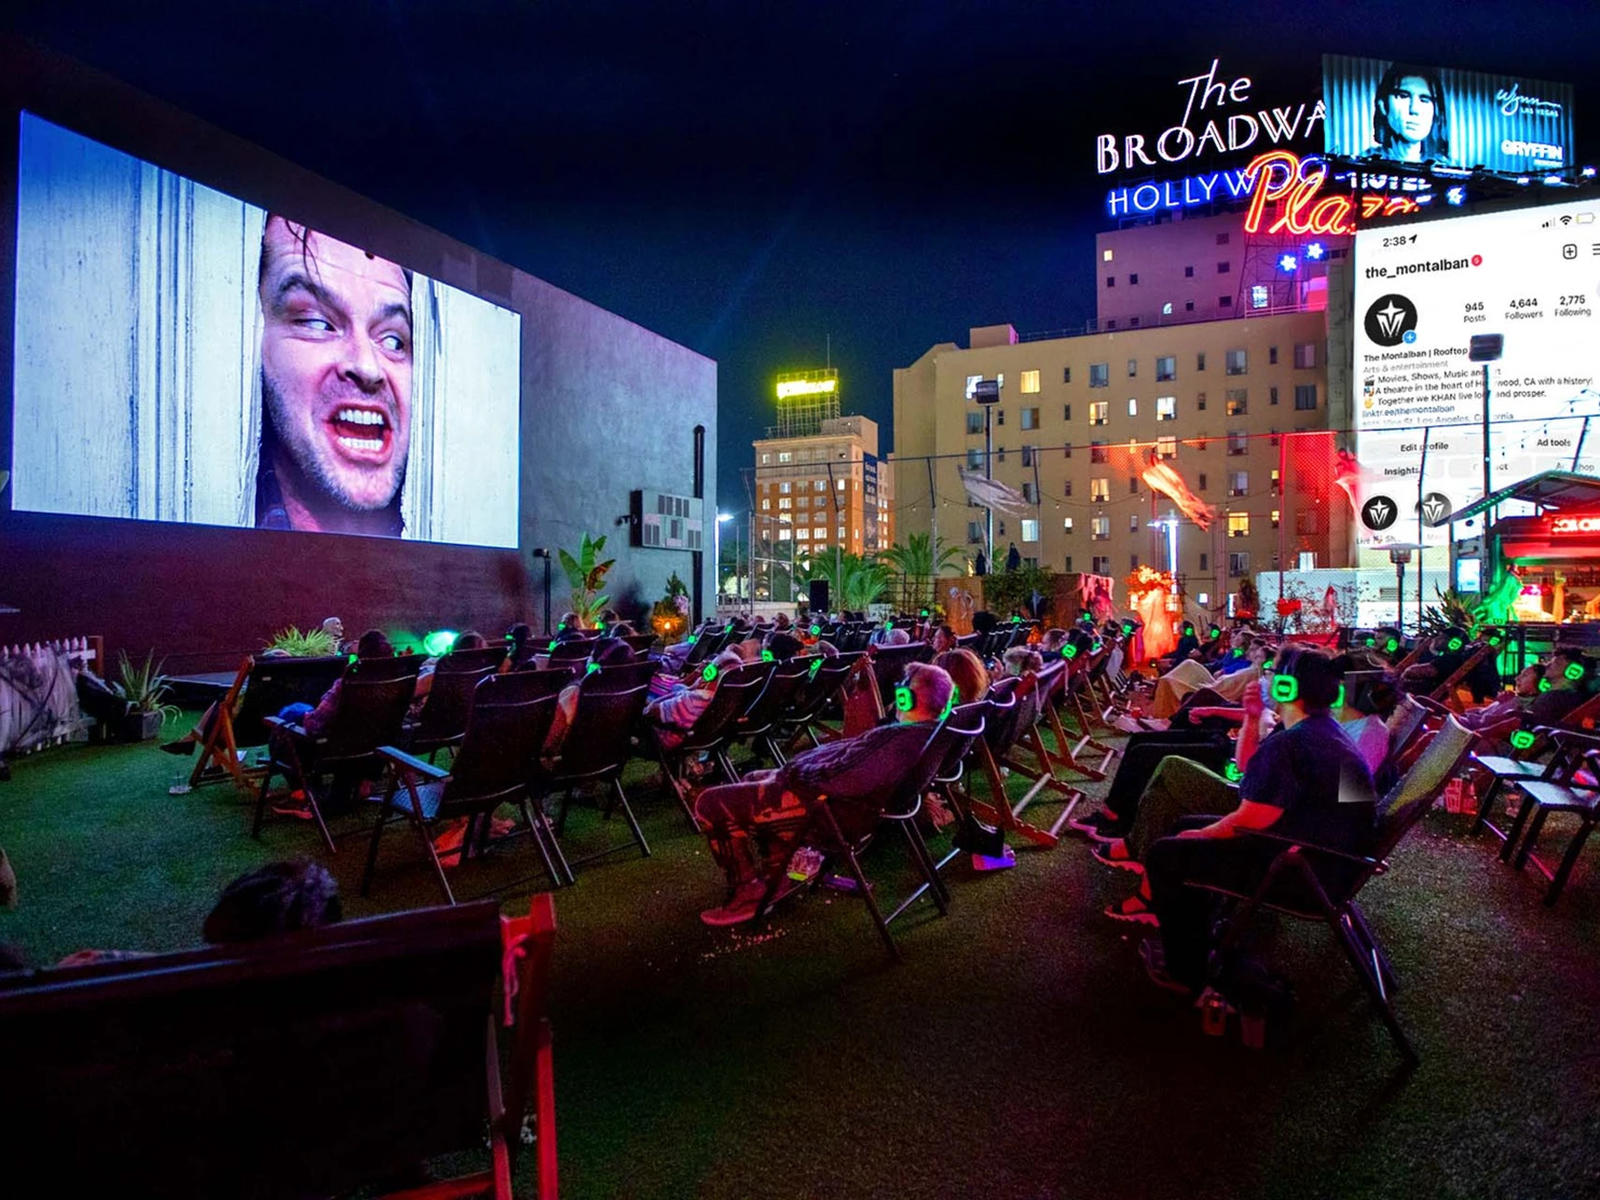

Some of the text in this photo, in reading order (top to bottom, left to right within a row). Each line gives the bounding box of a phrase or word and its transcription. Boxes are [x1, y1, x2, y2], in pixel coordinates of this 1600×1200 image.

[1178, 58, 1251, 143] The
[1097, 99, 1327, 173] BROADWA
[1501, 139, 1563, 160] GRYFFIN
[1109, 156, 1327, 215] HOLLYWOO
[1382, 235, 1407, 247] 2:38
[1365, 258, 1469, 279] the_montalban
[1465, 295, 1585, 312] 945 4,644 2,775
[1463, 308, 1591, 323] Posts Followers Following
[1381, 350, 1427, 360] Montalban
[1433, 347, 1468, 357] Rooftop
[1390, 361, 1448, 371] entertainment
[1411, 372, 1441, 380] Shows,
[1444, 370, 1468, 378] Music
[1470, 369, 1485, 377] an
[1375, 387, 1381, 395] A
[1383, 385, 1413, 394] theatre
[1425, 382, 1439, 390] the
[1465, 380, 1474, 388] of
[1523, 377, 1537, 386] CA
[1538, 376, 1555, 385] with
[1378, 395, 1414, 406] Together
[1416, 395, 1429, 403] we
[1431, 393, 1456, 402] KHAN
[1513, 390, 1547, 400] prosper.
[1400, 444, 1418, 452] Edit
[1536, 439, 1549, 447] Ad
[1550, 439, 1571, 447] tools
